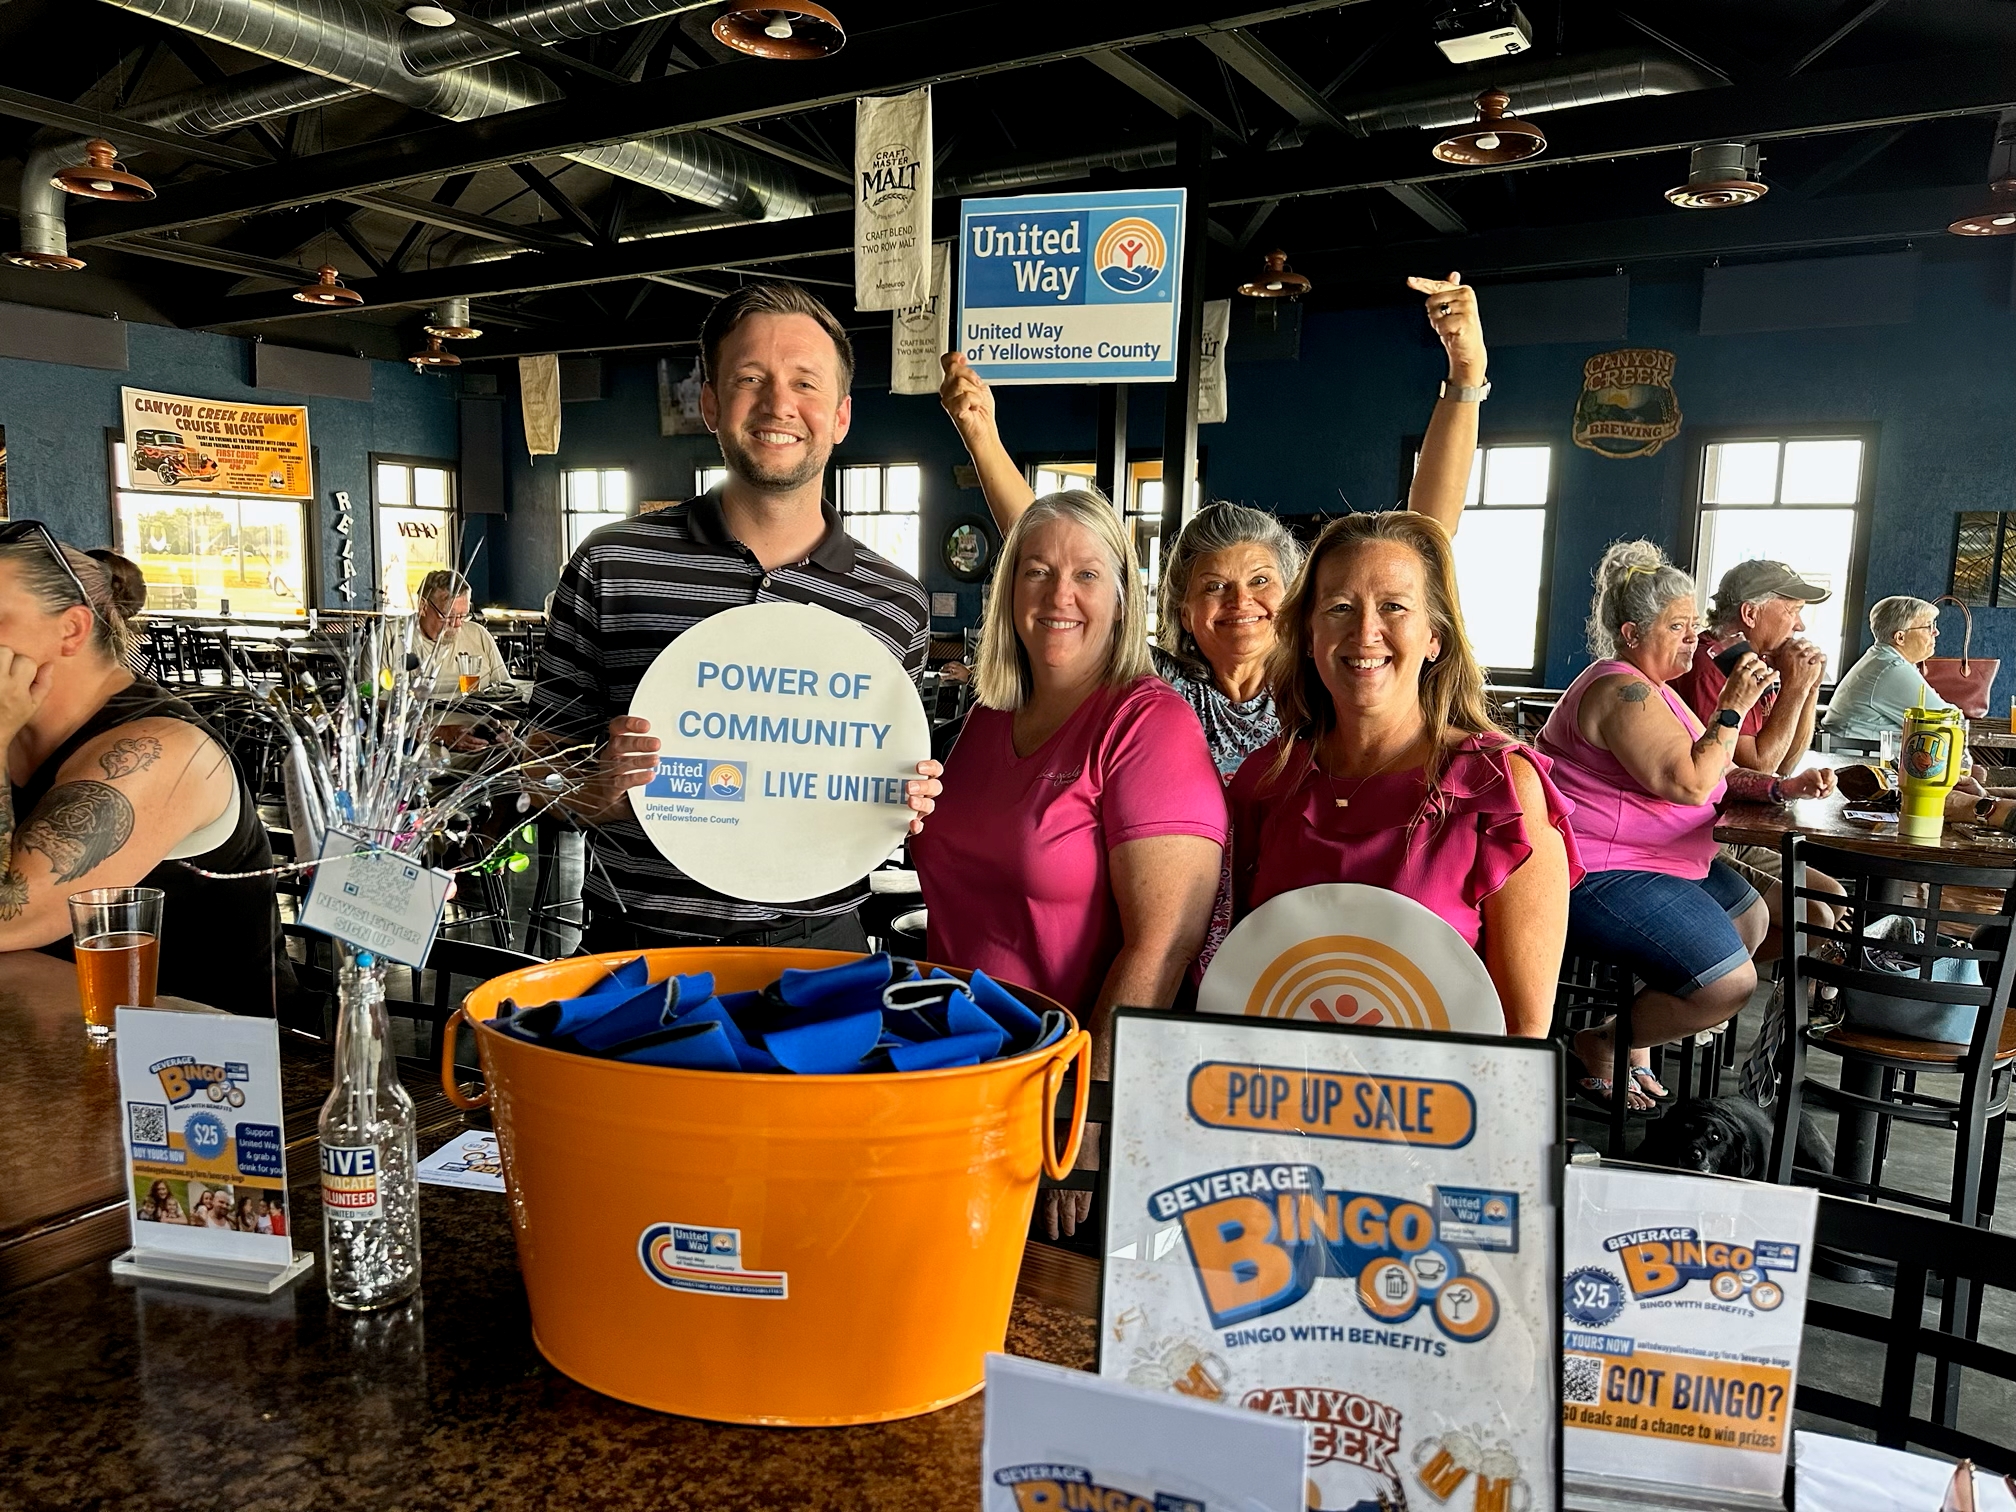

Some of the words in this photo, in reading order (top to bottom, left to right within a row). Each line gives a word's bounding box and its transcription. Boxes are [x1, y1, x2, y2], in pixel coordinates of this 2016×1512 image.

[873, 157, 908, 168] MASTER
[876, 149, 906, 160] CRAFT
[862, 162, 920, 202] MALT
[866, 230, 888, 242] CRAFT
[890, 226, 912, 238] BLEND
[972, 221, 1080, 258] United
[862, 245, 879, 255] TWO
[881, 242, 897, 252] ROW
[900, 238, 916, 248] MALT
[1013, 260, 1079, 300] Way
[968, 322, 1021, 340] United
[1027, 322, 1063, 341] Way
[968, 344, 984, 361] of
[989, 343, 1092, 360] Yellowstone
[1098, 342, 1161, 361] County
[1590, 352, 1671, 373] CANYON
[1588, 367, 1668, 390] CREEK
[135, 398, 193, 417] CANYON
[197, 407, 238, 422] CREEK
[240, 410, 298, 426] BREWING
[176, 419, 220, 434] CRUISE
[225, 422, 265, 437] NIGHT
[1590, 424, 1662, 438] BREWING
[216, 449, 235, 457] FIRST
[236, 450, 259, 459] CRUISE
[336, 492, 357, 602] RELAX
[698, 662, 818, 696] POWER
[829, 672, 871, 700] OF
[679, 710, 891, 749] COMMUNITY
[670, 778, 702, 797] Way
[764, 771, 817, 799] LIVE
[646, 804, 674, 812] United
[676, 805, 694, 814] Way
[657, 814, 708, 823] Yellowstone
[710, 816, 739, 825] County
[317, 892, 421, 945] NEWSLETTER
[334, 917, 371, 942] SIGN
[372, 932, 395, 948] UP
[152, 1056, 193, 1073] BEVERAGE
[157, 1064, 226, 1103] BINGO
[174, 1103, 190, 1111] BINGO
[206, 1104, 232, 1112] BENEFITS
[1228, 1072, 1289, 1120] POP
[1302, 1078, 1342, 1126] UP
[1354, 1082, 1433, 1133] SALE
[194, 1123, 218, 1145] $25
[245, 1127, 274, 1137] Support
[239, 1139, 263, 1149] United
[133, 1147, 146, 1158] BUY
[148, 1149, 169, 1160] YOURS
[170, 1151, 184, 1162] NOW
[246, 1151, 252, 1159] &
[253, 1152, 269, 1162] grab
[239, 1163, 257, 1172] drink
[258, 1164, 269, 1172] for
[1155, 1166, 1310, 1217] BEVERAGE
[1443, 1196, 1480, 1209] United
[330, 1209, 355, 1218] UNITED
[1458, 1208, 1479, 1222] Way
[676, 1229, 708, 1241] United
[1607, 1228, 1691, 1250] BEVERAGE
[688, 1241, 708, 1252] Way
[1183, 1193, 1434, 1322] BINGO
[1622, 1242, 1754, 1294] BINGO
[1573, 1279, 1610, 1309] $25
[1640, 1301, 1672, 1309] BINGO
[1674, 1301, 1702, 1309] WITH
[1704, 1302, 1754, 1318] BENEFITS
[1224, 1328, 1285, 1347] BINGO
[1290, 1326, 1344, 1342] WITH
[1348, 1329, 1447, 1357] BENEFITS
[1572, 1334, 1603, 1350] YOURS
[1606, 1337, 1630, 1354] NOW
[1606, 1364, 1665, 1406] GOT
[1672, 1372, 1784, 1422] BINGO?
[1245, 1390, 1398, 1438] CANYON
[1580, 1408, 1612, 1425] deals
[1616, 1414, 1637, 1428] and
[1641, 1418, 1648, 1430] a
[1651, 1418, 1694, 1435] chance
[1699, 1425, 1711, 1438] to
[1714, 1426, 1735, 1442] win
[1739, 1429, 1776, 1447] prizes
[1307, 1422, 1397, 1478] EEK
[1000, 1466, 1084, 1483] BEVERAGE
